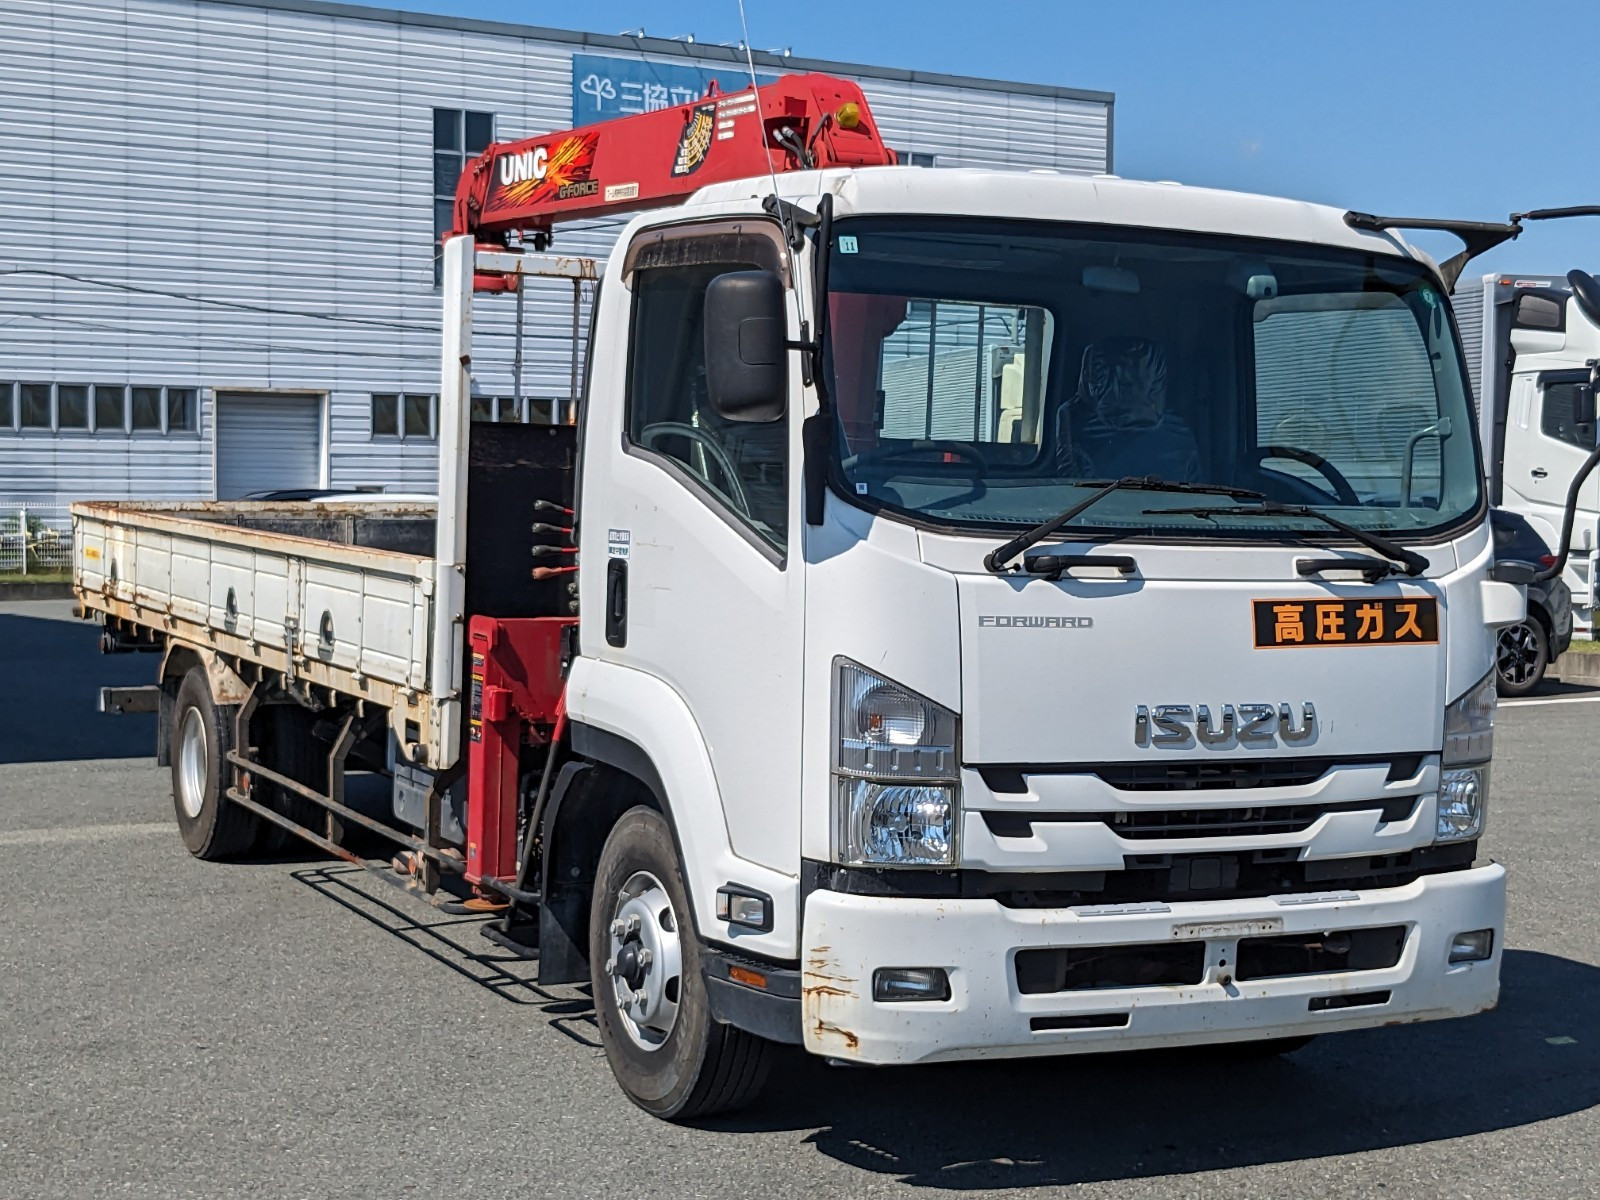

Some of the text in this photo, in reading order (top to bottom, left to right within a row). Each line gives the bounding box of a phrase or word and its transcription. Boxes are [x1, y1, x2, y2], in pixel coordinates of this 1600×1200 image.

[500, 147, 548, 186] UNIC
[978, 615, 1094, 628] FORWARD
[1272, 602, 1422, 643] 高圧ガス
[1134, 701, 1319, 745] ISUZU
